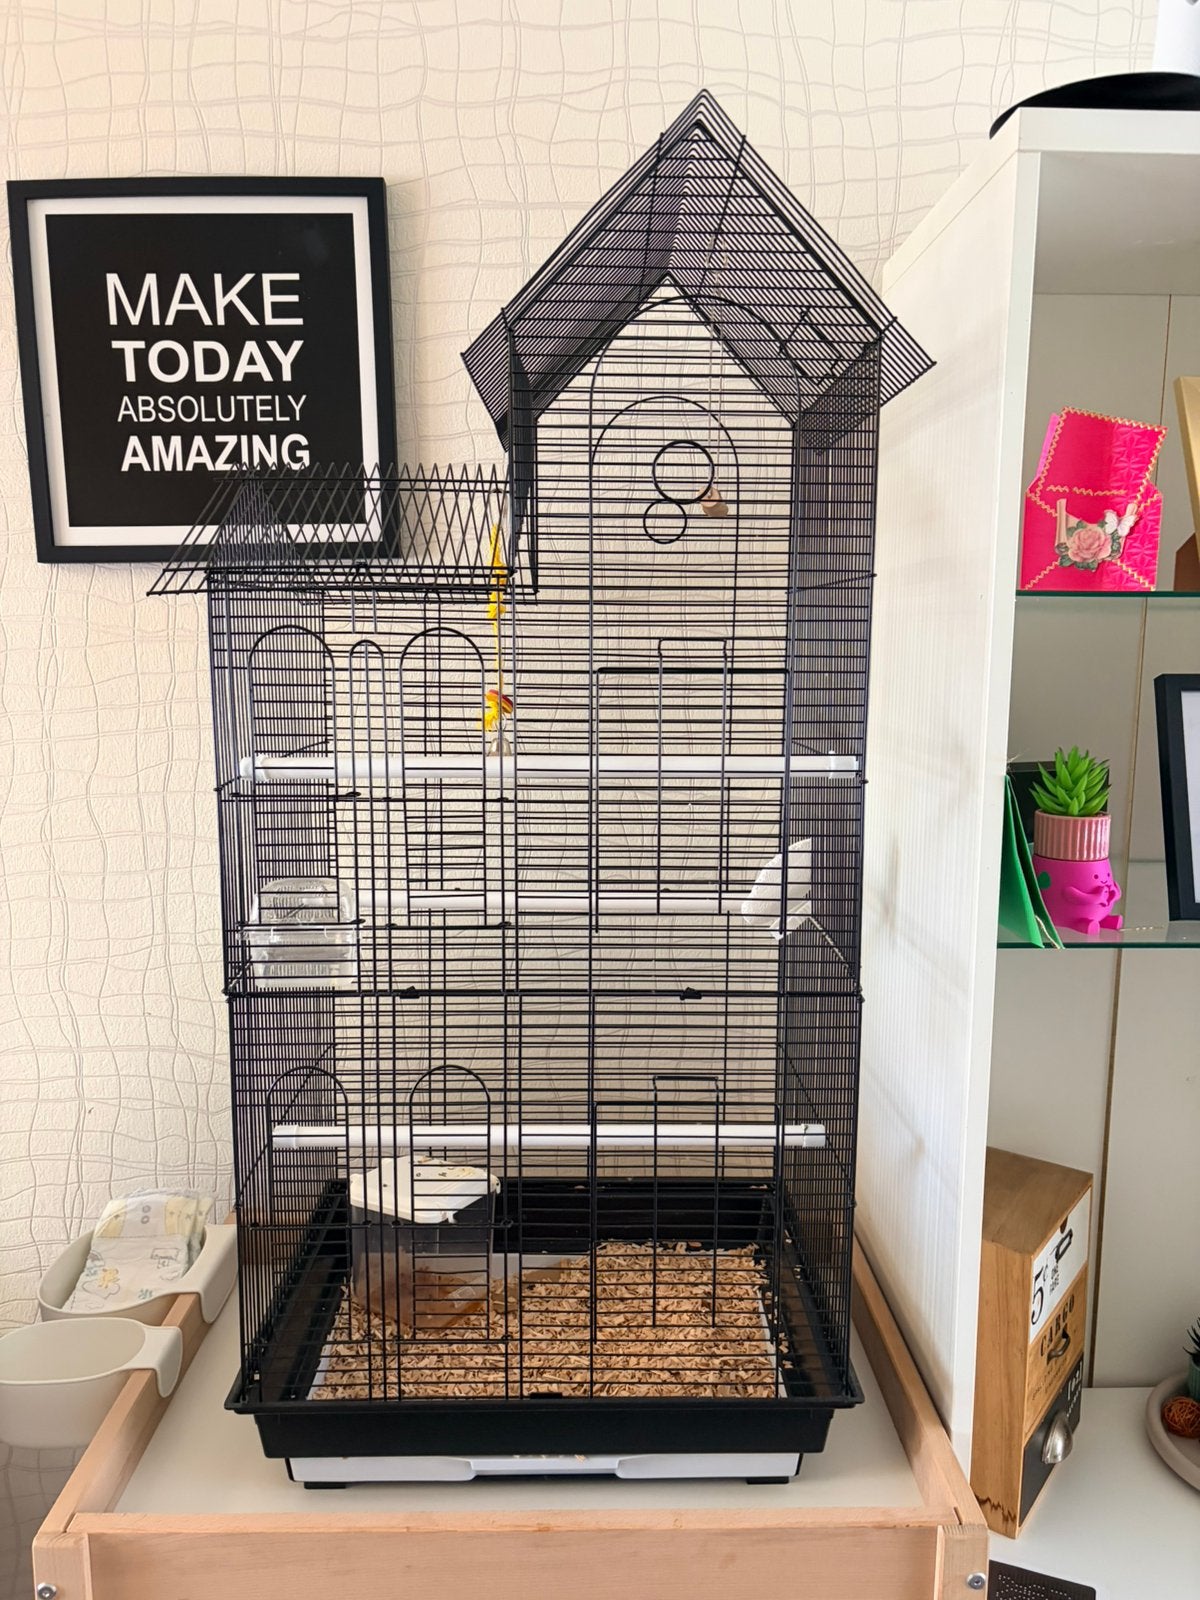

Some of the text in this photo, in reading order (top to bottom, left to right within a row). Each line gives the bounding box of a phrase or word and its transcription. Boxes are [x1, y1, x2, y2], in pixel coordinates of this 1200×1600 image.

[106, 272, 304, 326] MAKE
[111, 339, 304, 383] TODAY
[117, 395, 307, 423] ABSOLUTELY
[121, 433, 311, 472] AMAZING
[1040, 1294, 1075, 1357] CARGO
